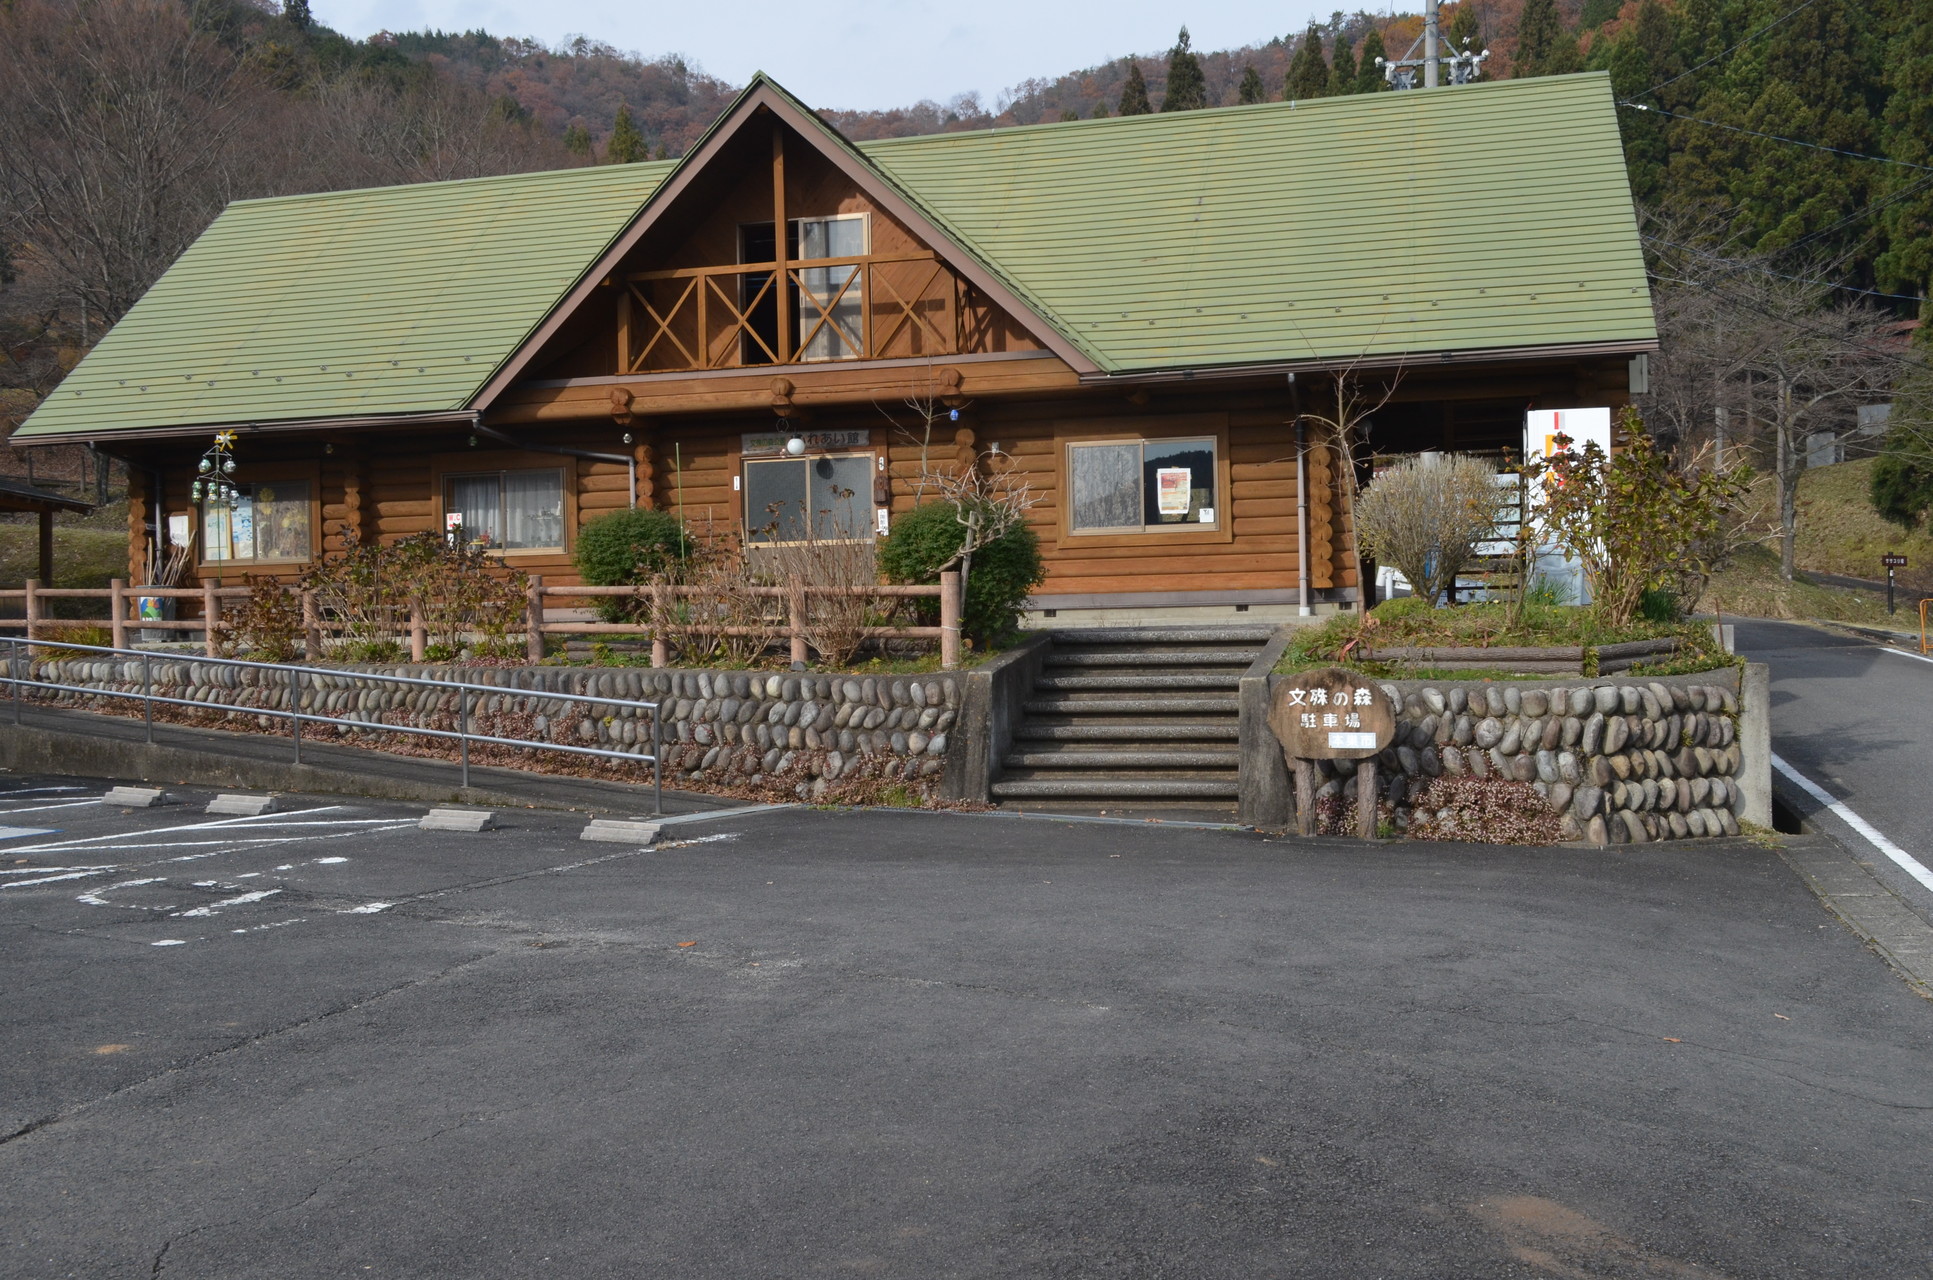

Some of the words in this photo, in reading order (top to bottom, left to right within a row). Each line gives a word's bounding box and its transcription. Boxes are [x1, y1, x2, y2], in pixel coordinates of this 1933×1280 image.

[1288, 687, 1373, 707] 文殊の森
[1300, 712, 1361, 728] 駐車場
